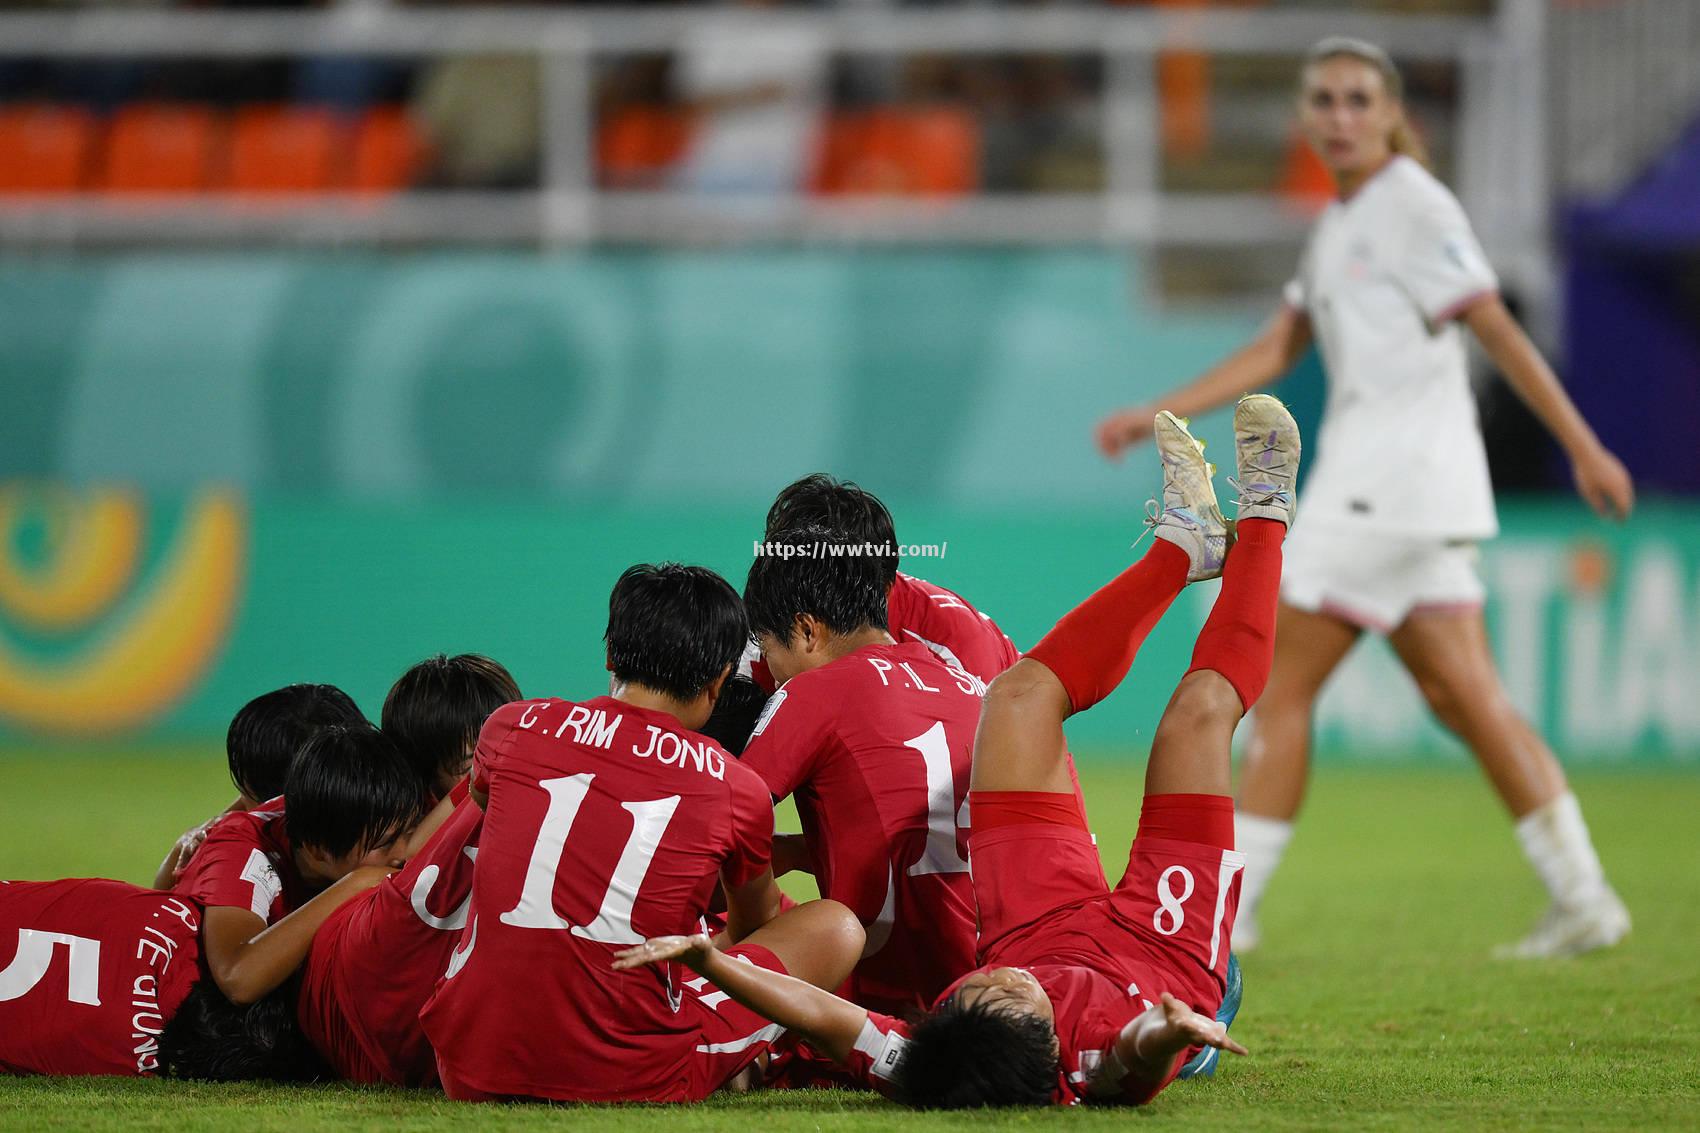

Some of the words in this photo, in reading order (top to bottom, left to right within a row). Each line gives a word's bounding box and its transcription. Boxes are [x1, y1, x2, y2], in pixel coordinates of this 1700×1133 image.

[632, 725, 725, 781] JONG
[500, 772, 682, 945] 11
[1153, 865, 1195, 936] 8
[0, 928, 102, 1007] 5
